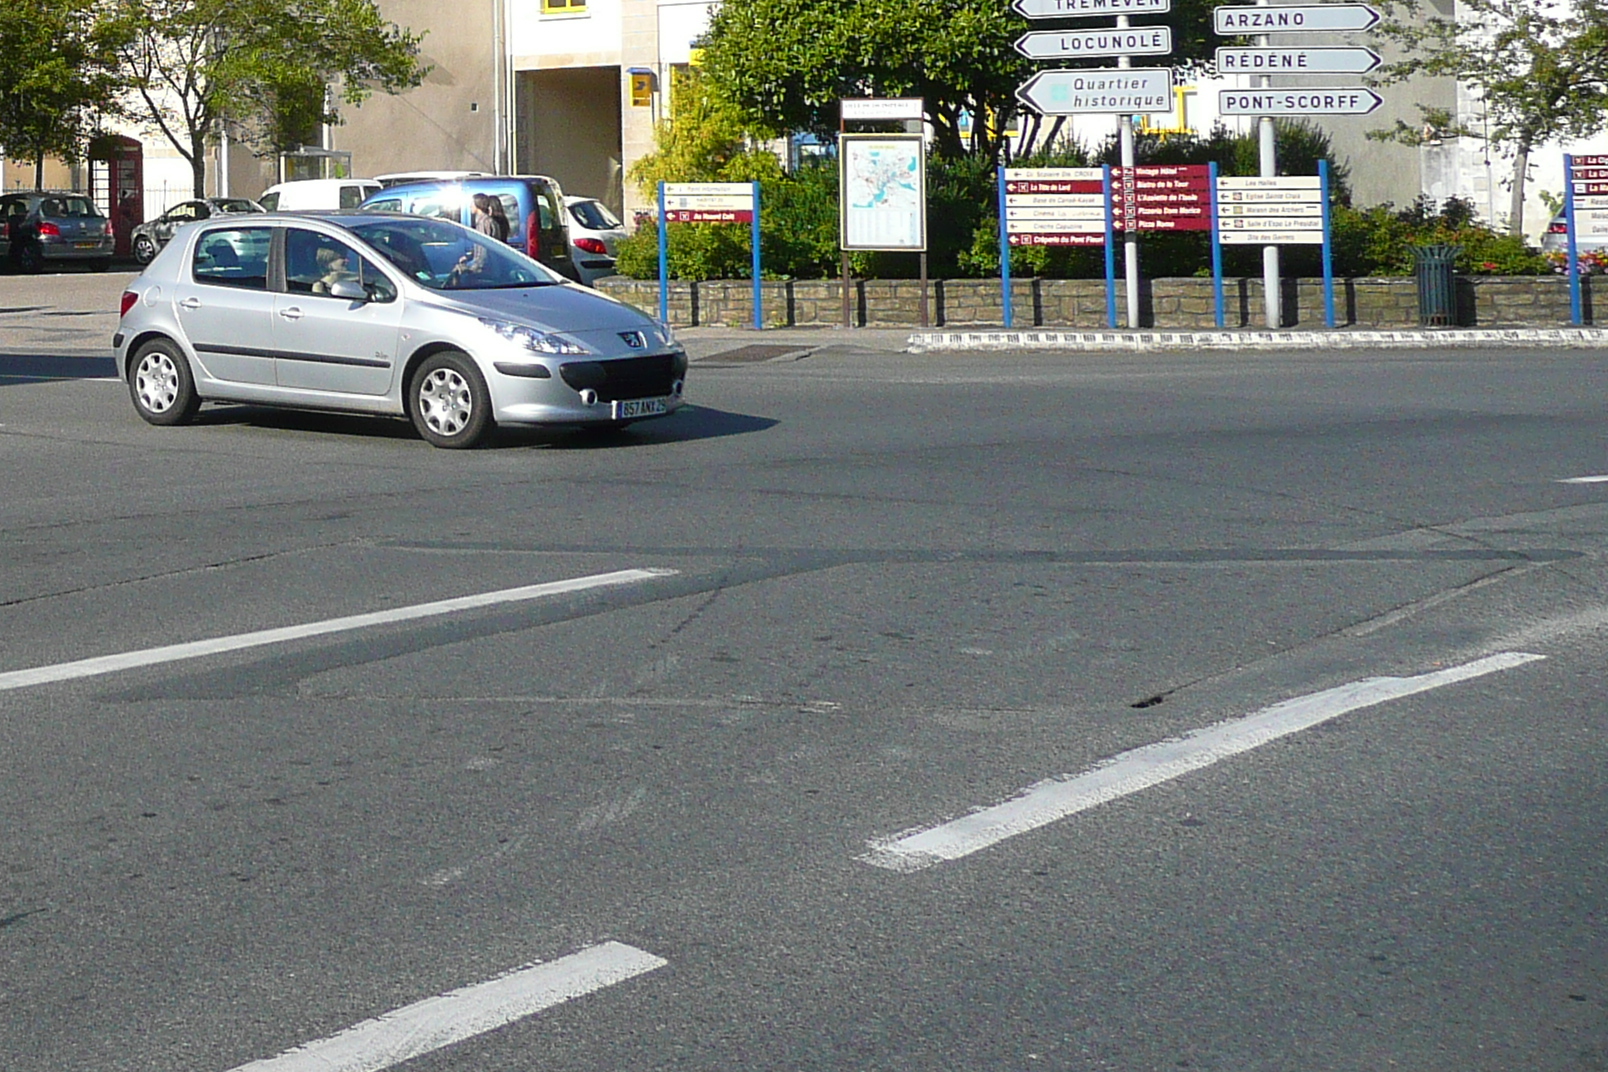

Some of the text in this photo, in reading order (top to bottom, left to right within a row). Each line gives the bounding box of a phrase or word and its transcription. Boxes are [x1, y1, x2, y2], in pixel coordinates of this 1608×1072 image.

[1225, 13, 1304, 27] ARZANO
[1061, 31, 1162, 50] LOCUNOLÉ
[1225, 51, 1308, 68] RÉDÉNÉ
[1074, 78, 1148, 91] Quartier
[1074, 95, 1164, 109] historique
[1227, 95, 1360, 109] PONT-SCORFF
